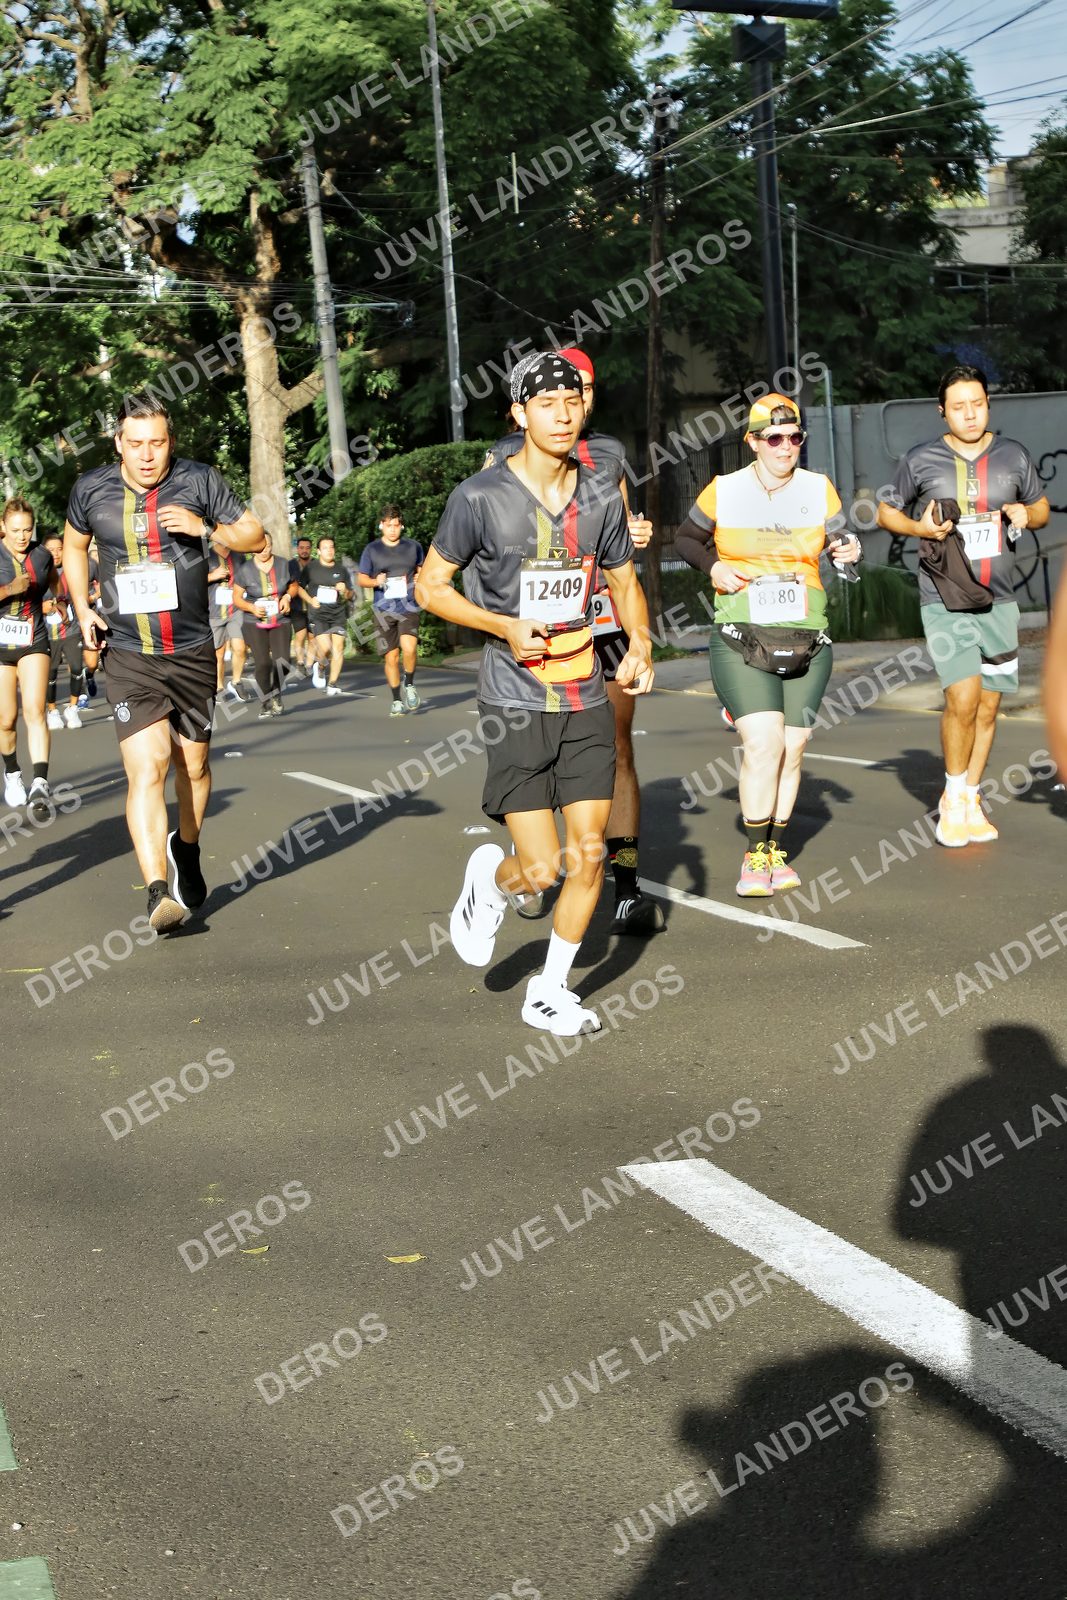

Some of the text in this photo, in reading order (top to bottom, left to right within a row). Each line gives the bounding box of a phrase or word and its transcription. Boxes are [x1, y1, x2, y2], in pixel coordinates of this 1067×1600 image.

[130, 579, 159, 595] 155
[525, 577, 583, 601] 12409
[593, 600, 603, 617] 9
